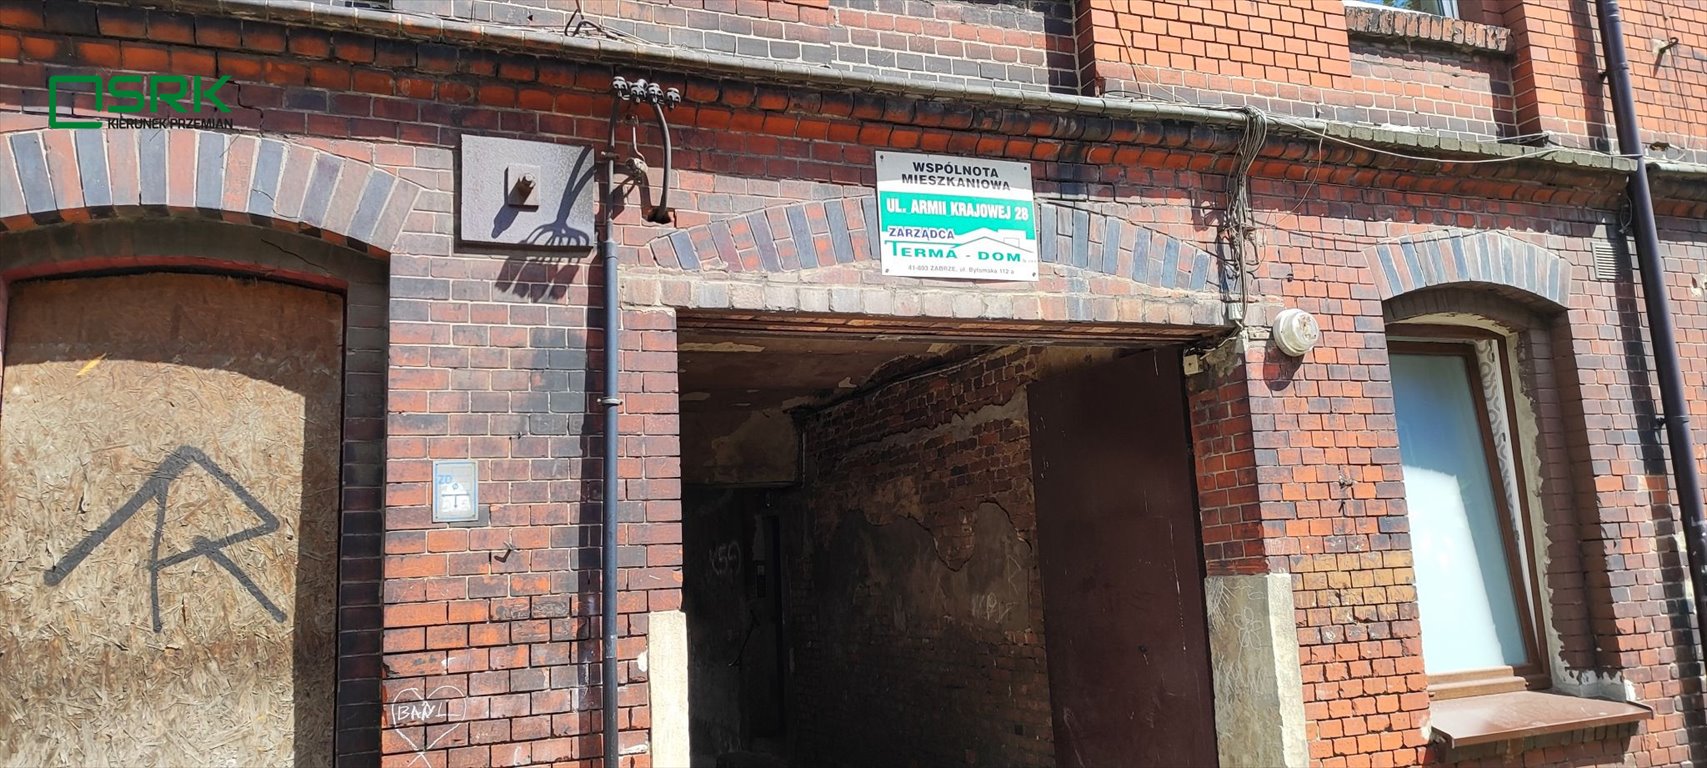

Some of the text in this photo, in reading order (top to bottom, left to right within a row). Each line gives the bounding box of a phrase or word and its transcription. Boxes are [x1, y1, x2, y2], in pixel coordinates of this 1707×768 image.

[912, 161, 999, 178] WSPÓLNOTA
[901, 174, 1011, 191] MIESZKANIOWA
[886, 198, 1029, 221] UL. ARMII KRAJOWEJ 28
[889, 227, 955, 241] ZARZĄDCA
[884, 240, 958, 259] TERMA
[978, 251, 1021, 262] DOM
